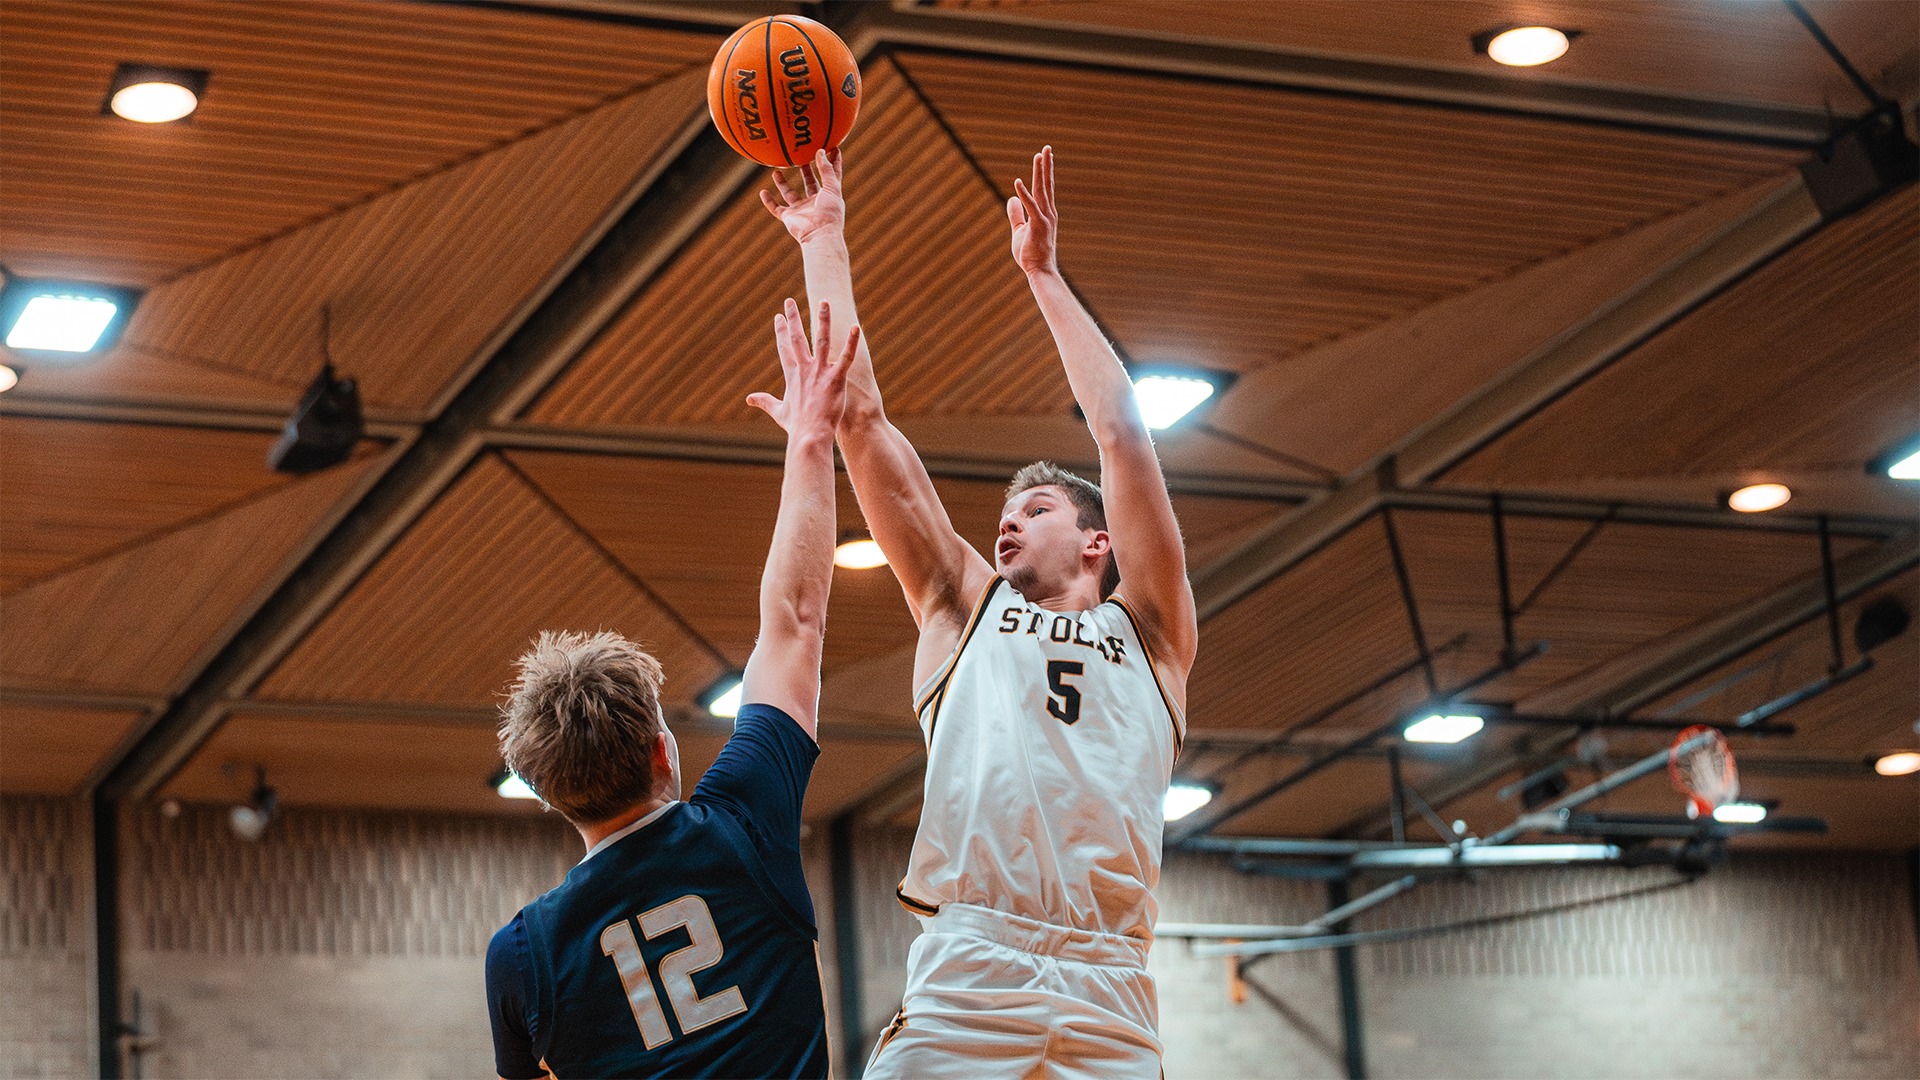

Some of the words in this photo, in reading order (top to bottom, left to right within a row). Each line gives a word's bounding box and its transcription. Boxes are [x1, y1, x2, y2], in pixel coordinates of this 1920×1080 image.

[736, 69, 768, 141] NCAA
[779, 45, 815, 148] Wilson
[1046, 659, 1084, 726] 5
[600, 894, 748, 1051] 12
